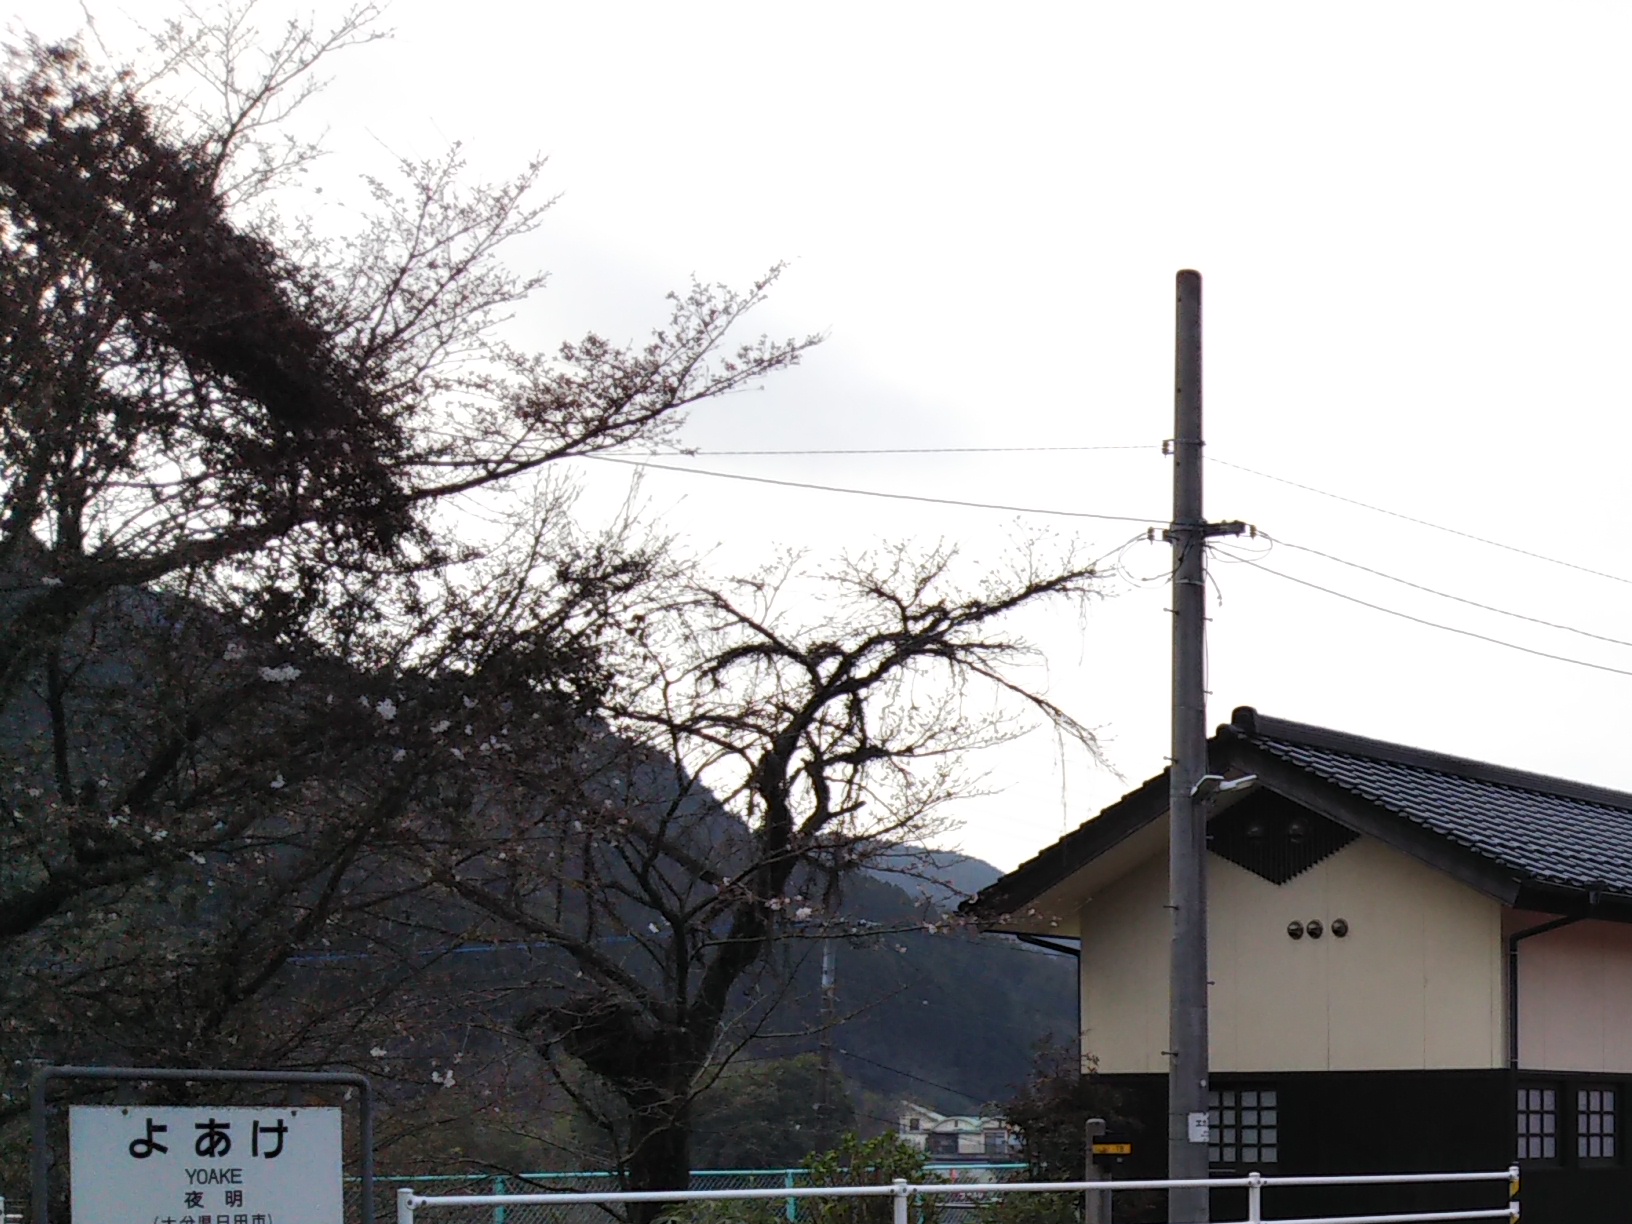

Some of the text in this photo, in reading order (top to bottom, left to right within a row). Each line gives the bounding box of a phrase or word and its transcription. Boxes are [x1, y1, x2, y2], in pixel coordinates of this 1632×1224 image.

[128, 1117, 289, 1159] よあけ
[184, 1168, 243, 1185] YOAKE
